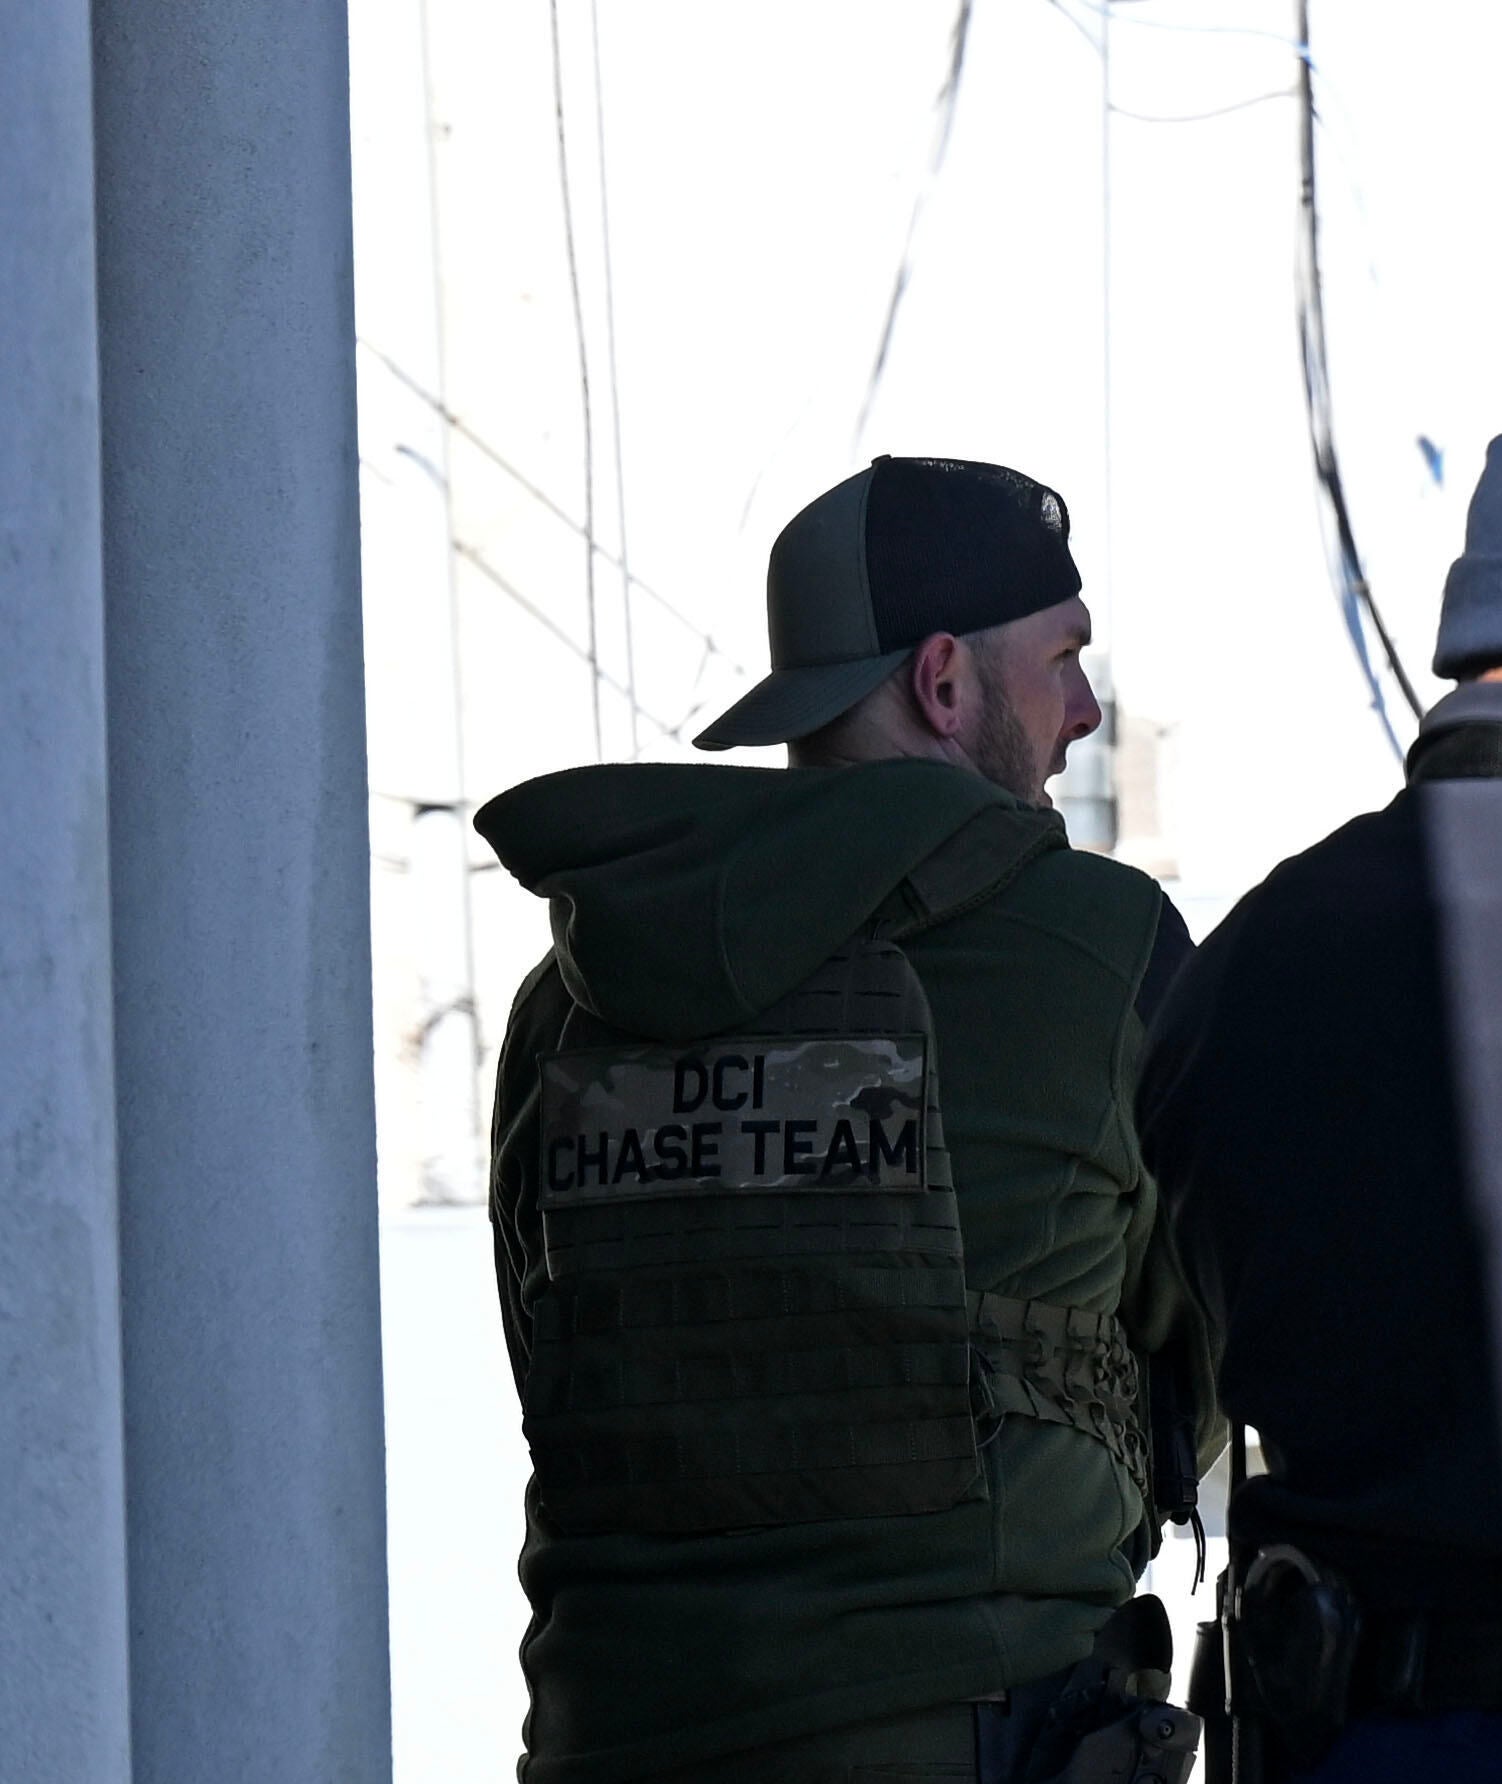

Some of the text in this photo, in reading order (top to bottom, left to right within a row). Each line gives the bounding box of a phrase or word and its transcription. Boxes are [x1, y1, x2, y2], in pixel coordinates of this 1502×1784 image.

[673, 1055, 765, 1113] DCI
[548, 1119, 918, 1192] CHASE TEAM
